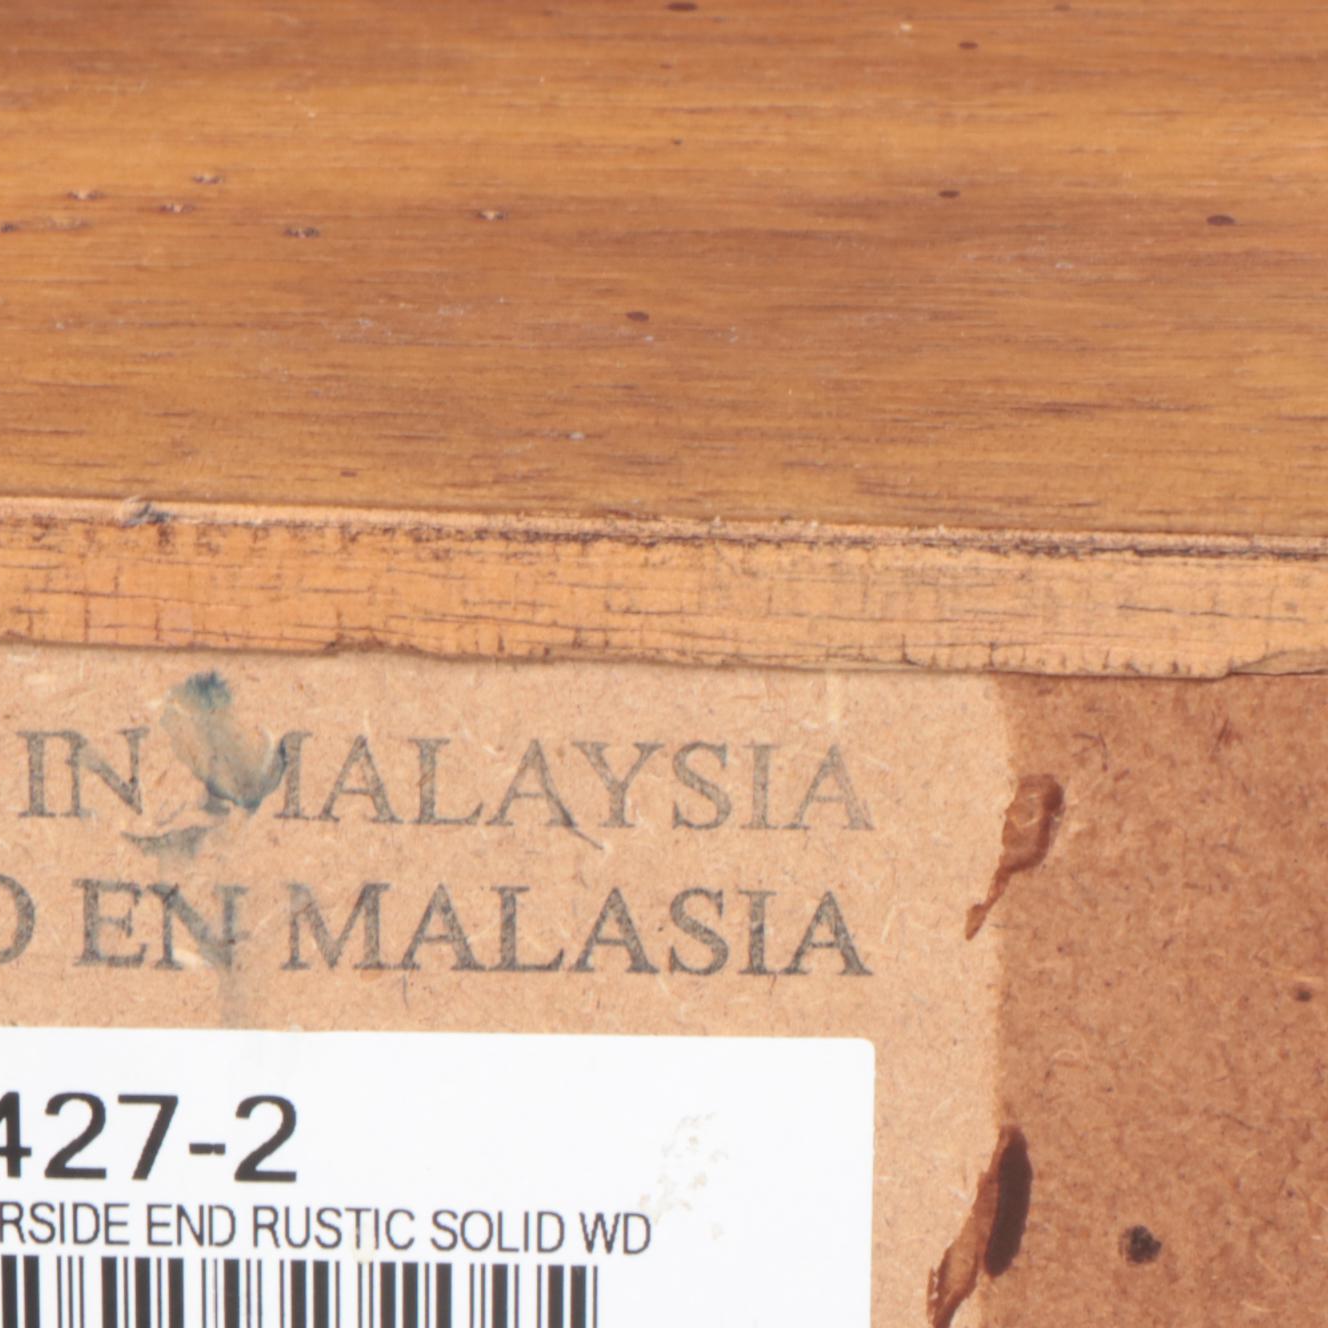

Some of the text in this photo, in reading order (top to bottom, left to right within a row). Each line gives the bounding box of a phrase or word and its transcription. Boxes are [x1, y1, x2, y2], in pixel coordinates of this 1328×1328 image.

[17, 728, 147, 820] IN
[76, 876, 250, 972] EN
[280, 882, 872, 978] MALASIA
[147, 1204, 236, 1249] END
[253, 1206, 414, 1251] RUSTIC
[430, 1210, 565, 1254] SOLID
[580, 1211, 652, 1255] WD
